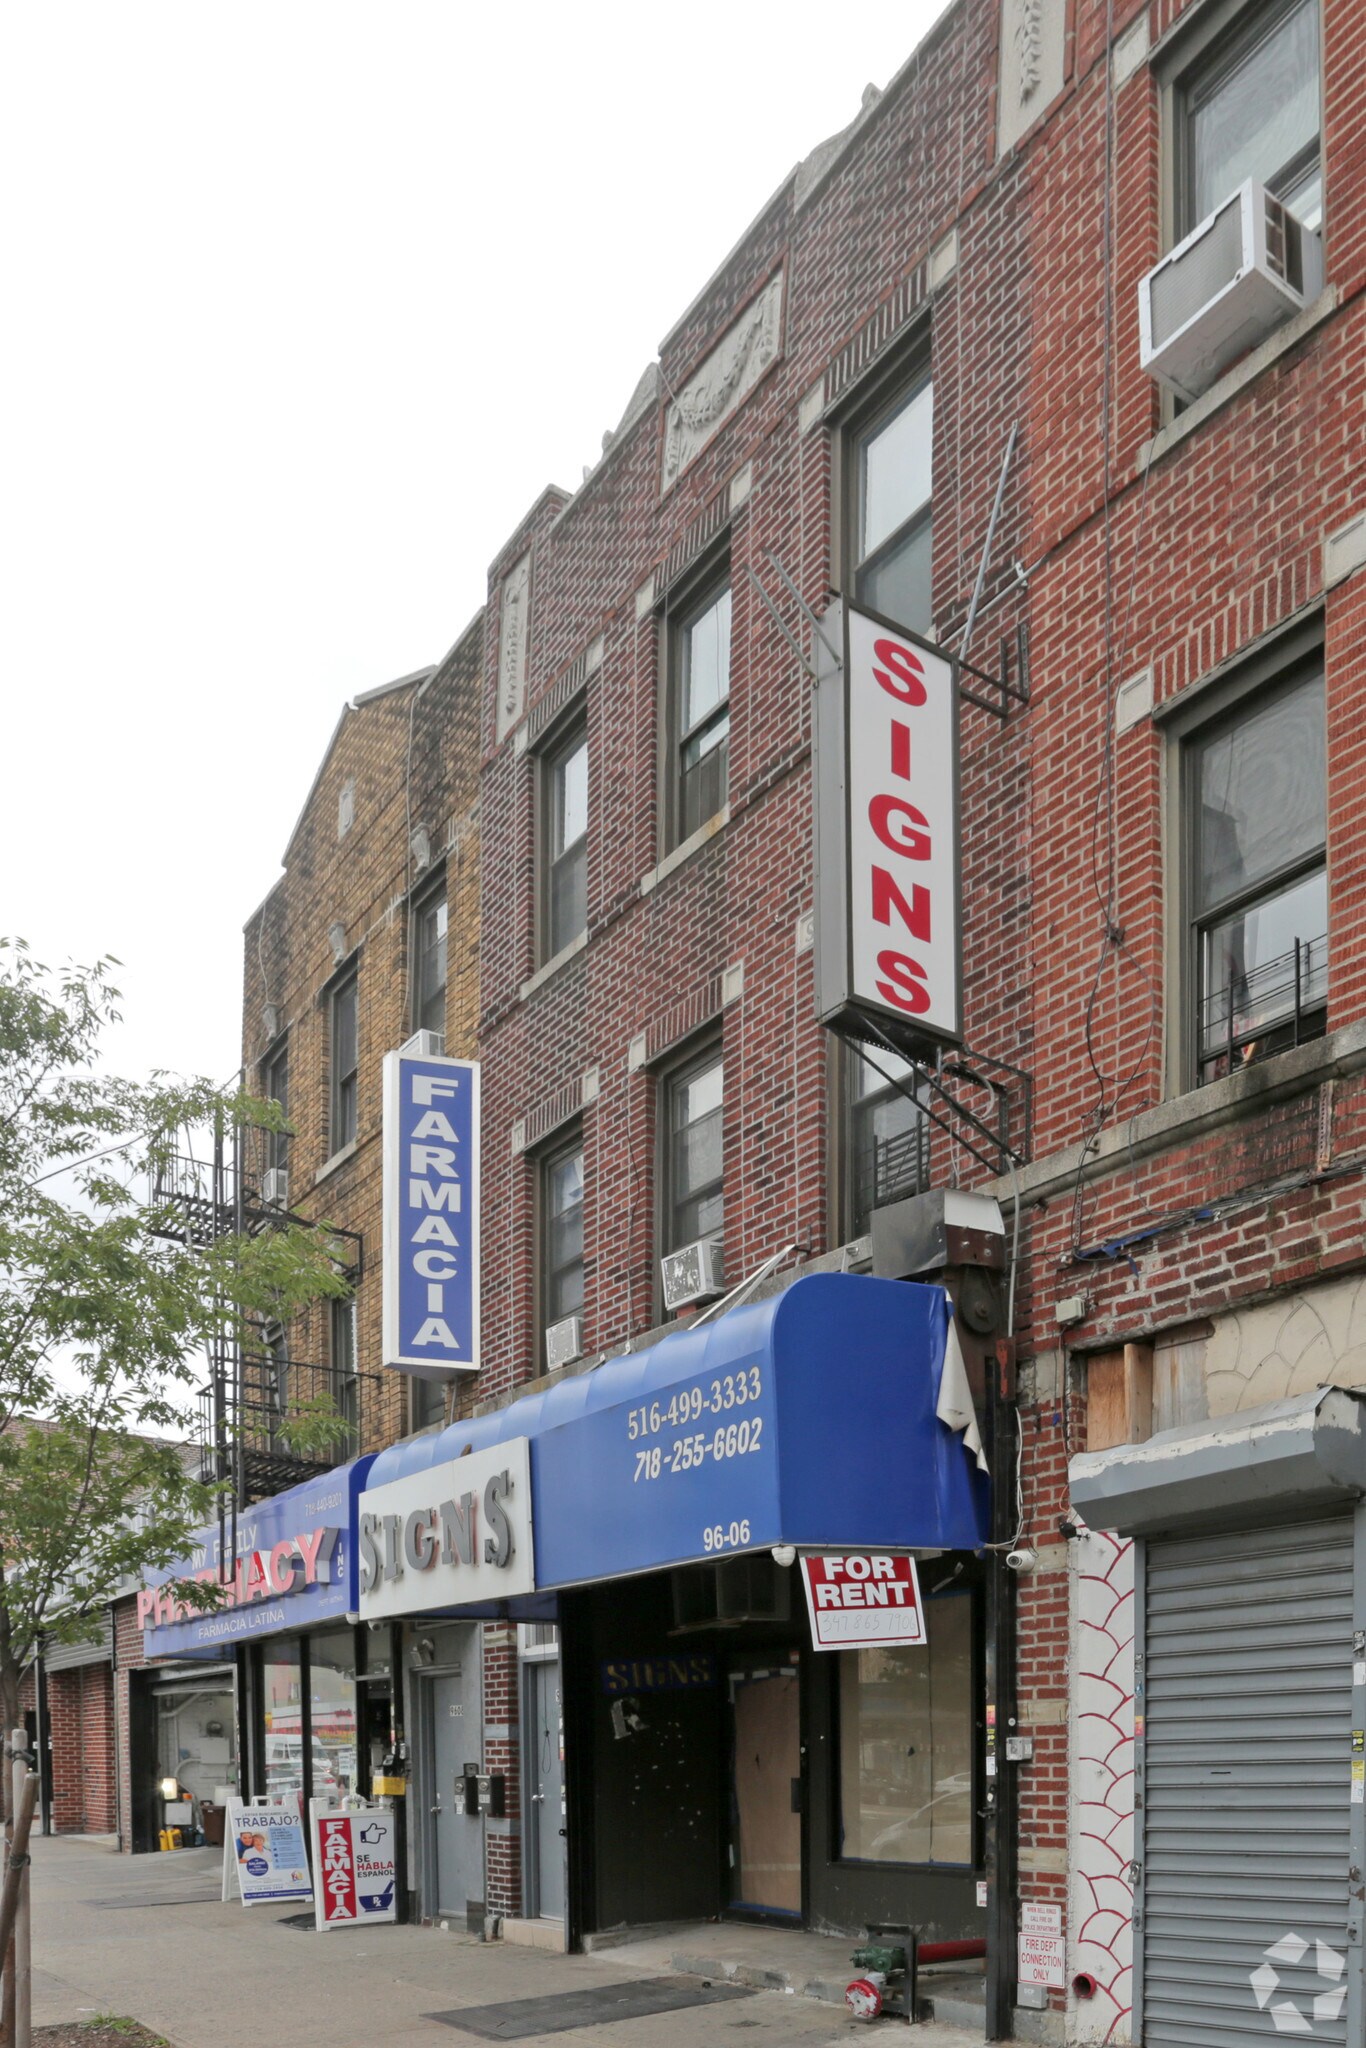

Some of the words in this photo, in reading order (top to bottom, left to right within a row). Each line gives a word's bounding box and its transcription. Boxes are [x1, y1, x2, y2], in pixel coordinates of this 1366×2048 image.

[867, 638, 932, 1015] SIGNS
[409, 1073, 461, 1349] FARMACIA
[628, 1366, 762, 1440] 516-499-3333
[359, 1469, 513, 1596] SIGNS
[703, 1519, 750, 1551] 96-06
[823, 1556, 896, 1580] FOR
[815, 1581, 909, 1608] RENT
[198, 1618, 247, 1639] FARMACIA
[248, 1608, 285, 1629] LATINA
[823, 1613, 849, 1633] 347
[853, 1613, 880, 1631] 865
[234, 1815, 299, 1827] TRABAJO?
[324, 1821, 353, 1919] FARMACIA
[356, 1854, 370, 1863] SE
[357, 1861, 394, 1871] HABLA
[1025, 1938, 1039, 1950] FIRE
[1040, 1940, 1057, 1952] DEPT
[1021, 1952, 1062, 1967] CONNECTION
[1033, 1968, 1050, 1981] ONLY
